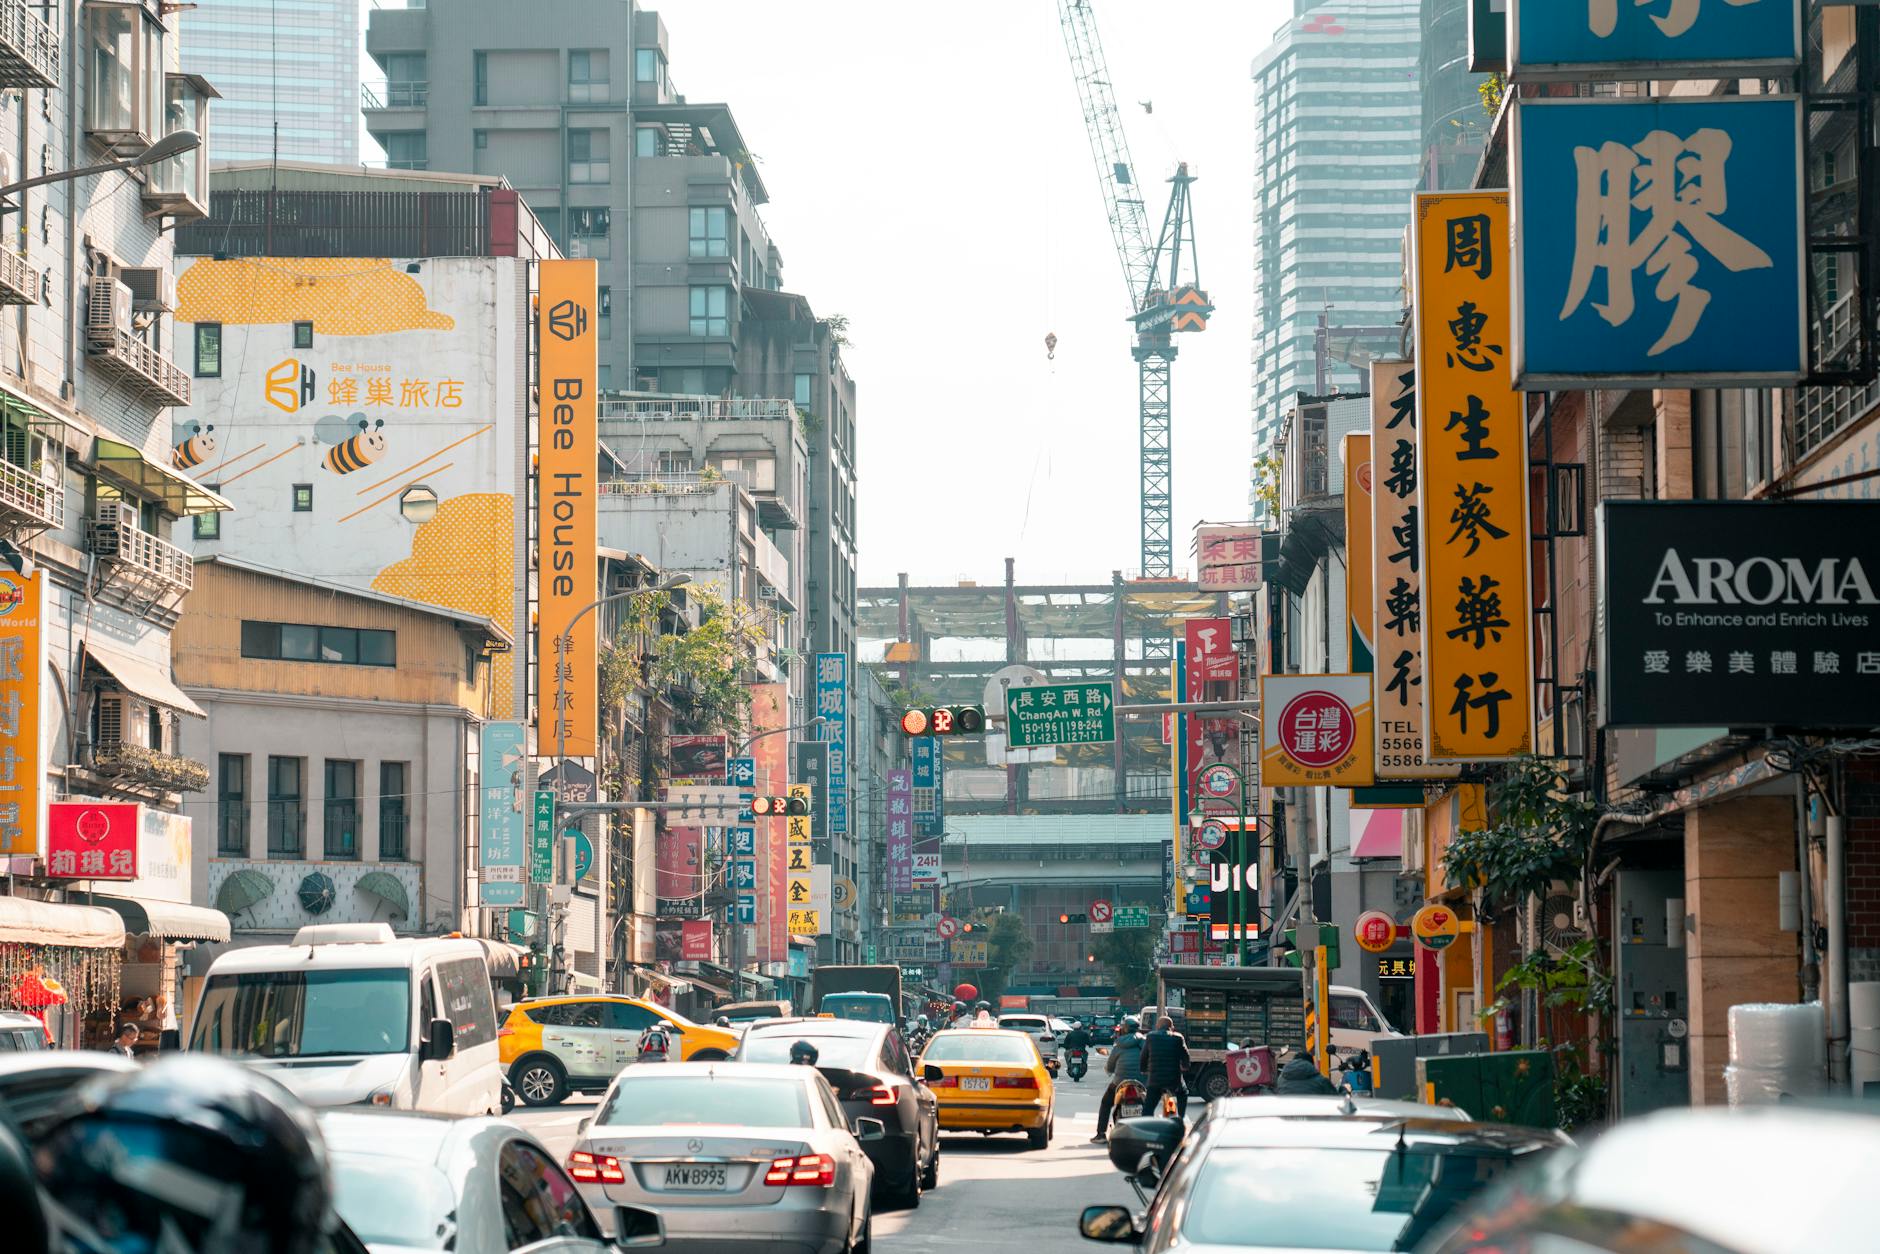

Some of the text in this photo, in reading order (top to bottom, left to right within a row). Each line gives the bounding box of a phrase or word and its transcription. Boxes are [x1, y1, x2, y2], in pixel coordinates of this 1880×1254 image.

[1559, 127, 1774, 357] 膠
[331, 362, 392, 373] Bee House
[327, 377, 465, 408] 蜂巢旅店
[553, 378, 583, 597] Bee House
[1202, 533, 1257, 560] 東東
[1201, 565, 1257, 584] 玩具城
[1642, 548, 1880, 605] AROMA
[1654, 612, 1869, 626] To Enhance and Enrich Lives
[1643, 650, 1880, 675] 愛樂美體驗店
[1018, 689, 1102, 707] 長安西路
[935, 712, 950, 732] 32
[1019, 708, 1103, 721] ChangAn W. Rd.
[1295, 706, 1341, 729] 台灣
[1021, 720, 1102, 733] 150-196 198-244
[1381, 721, 1418, 733] TEL
[1025, 731, 1103, 744] 81-123 127-171
[1293, 730, 1342, 752] 運彩
[1382, 738, 1422, 750] 5566
[774, 800, 786, 813] 32
[538, 803, 550, 849] 太原路
[917, 856, 939, 867] 24H
